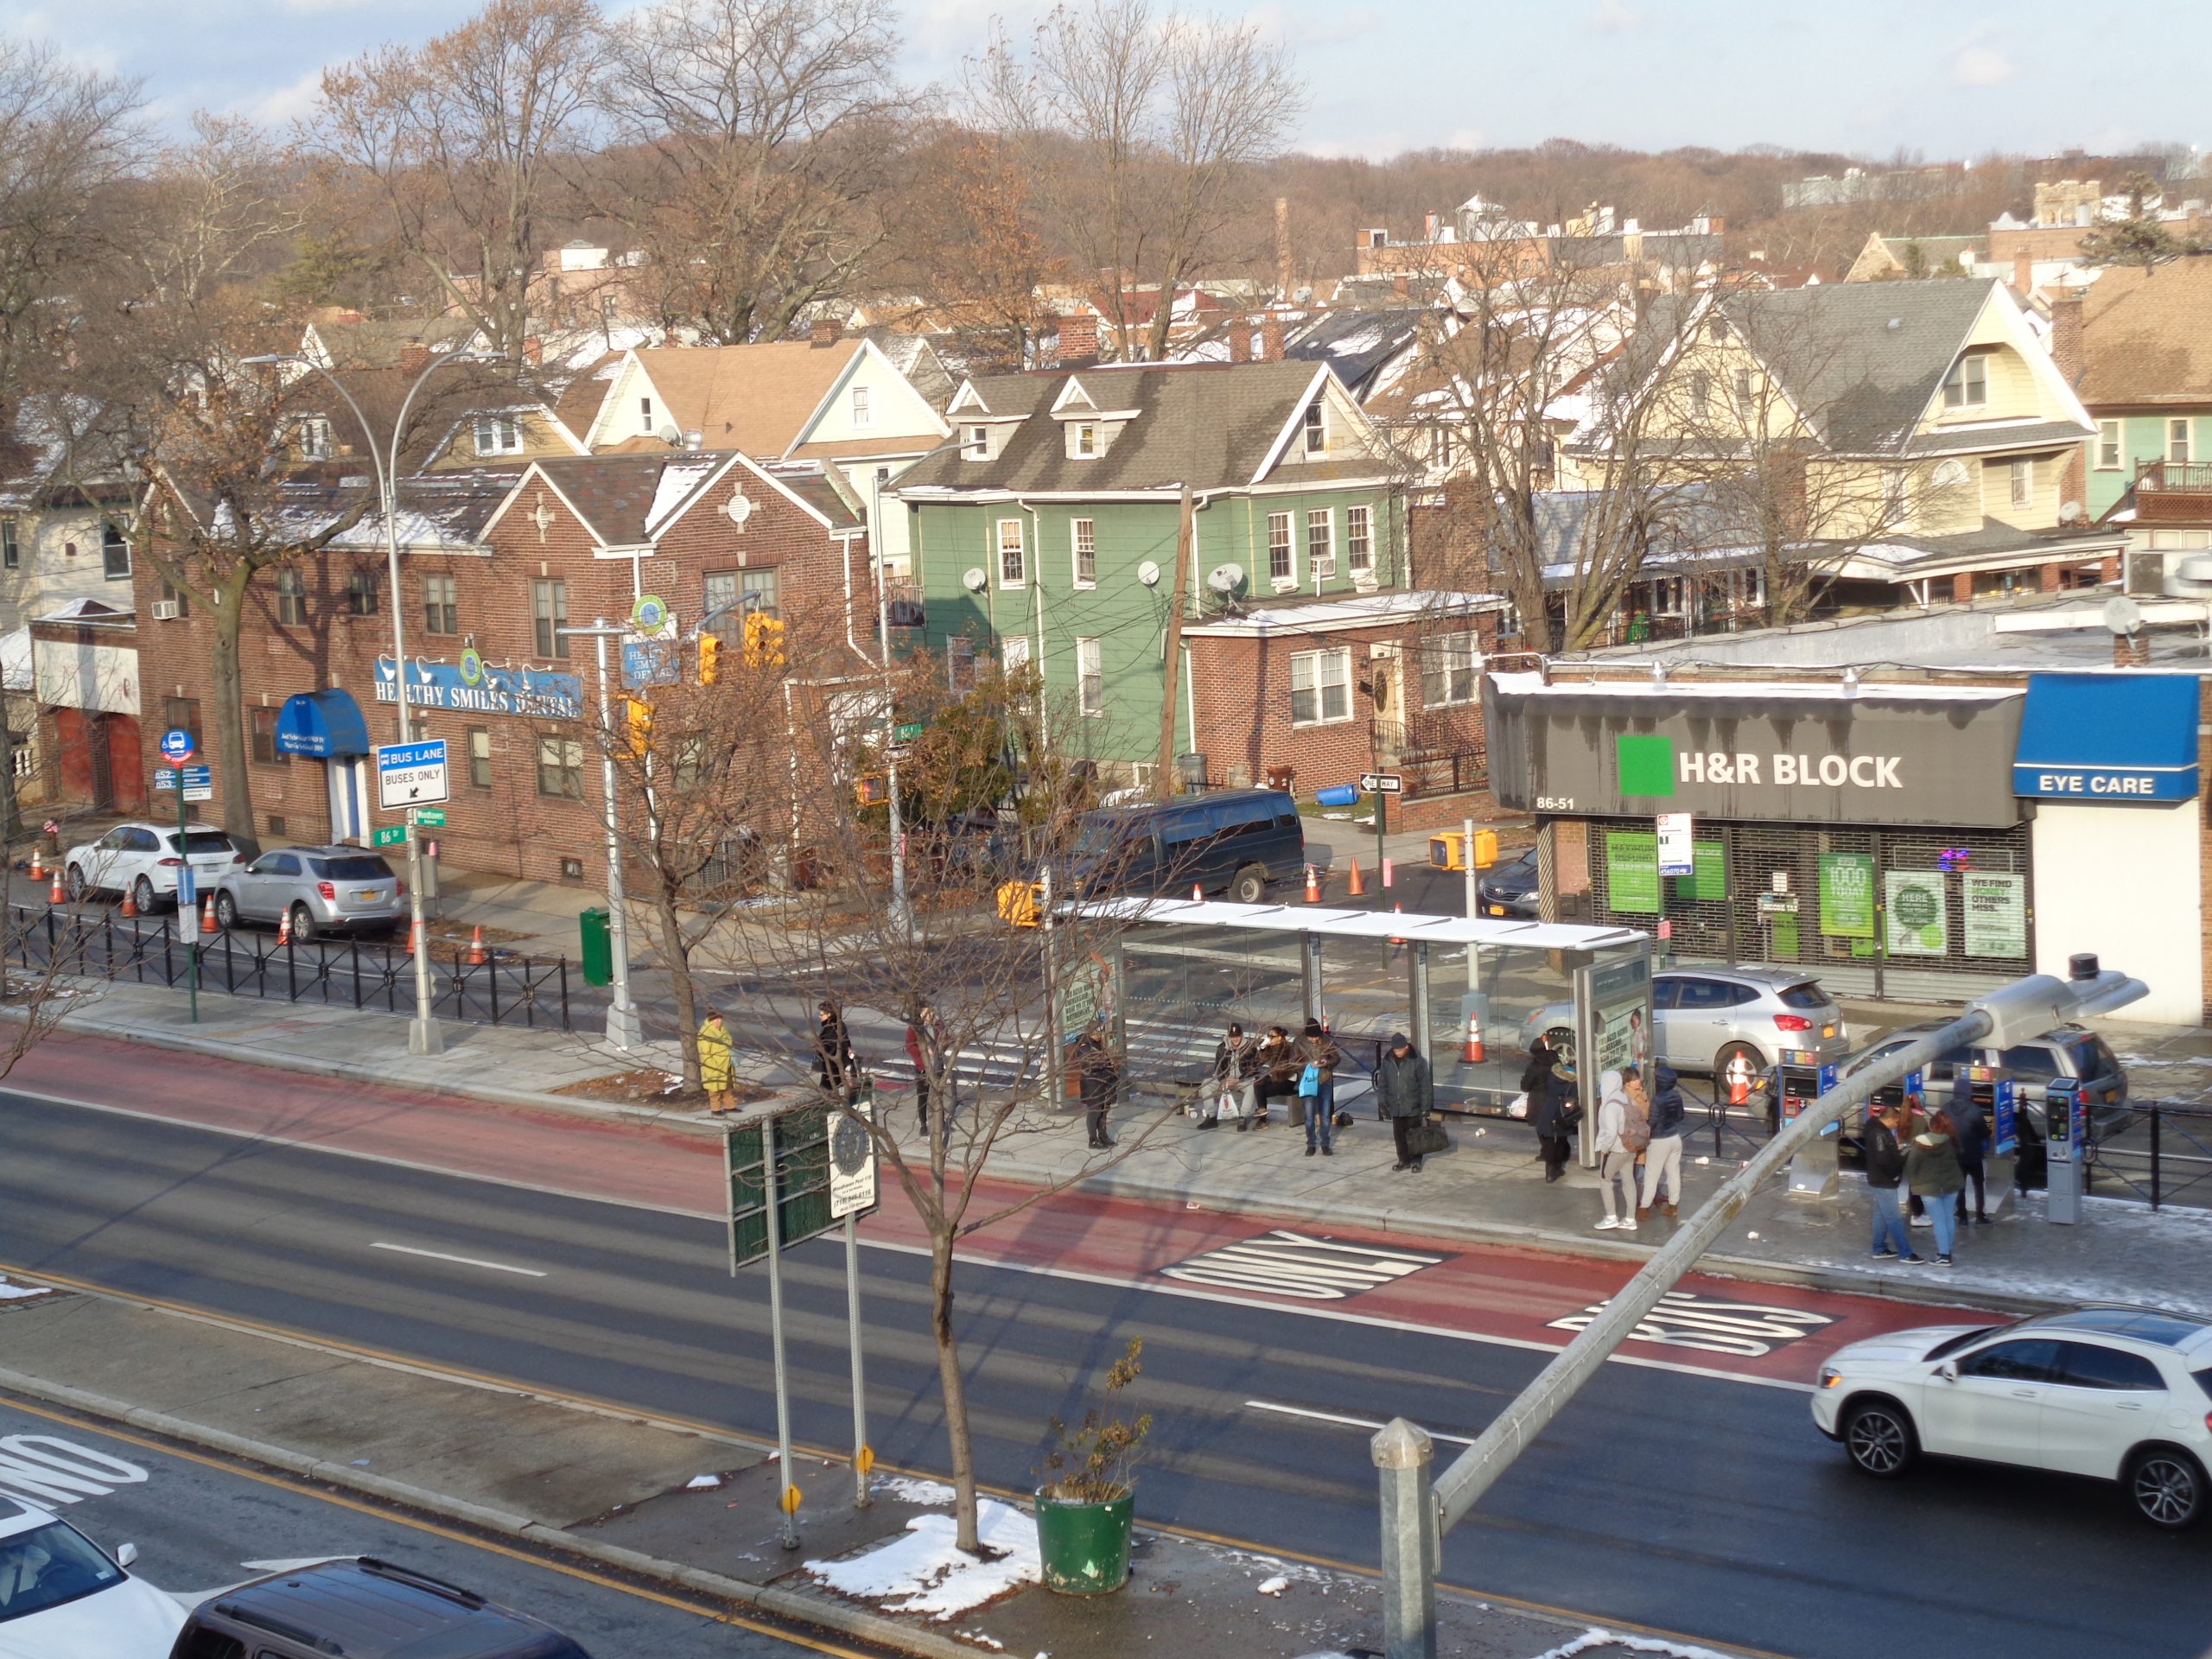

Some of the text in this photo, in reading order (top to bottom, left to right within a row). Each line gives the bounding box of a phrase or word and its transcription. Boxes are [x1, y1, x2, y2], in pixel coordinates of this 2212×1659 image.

[375, 681, 444, 706] HELTHY
[450, 687, 509, 712] SMILES
[391, 747, 444, 764] BUS LANE
[385, 768, 441, 785] BUSES ONLY
[1679, 752, 1903, 789] H&R BLOCK
[2039, 774, 2154, 794] EYE CARE
[1536, 797, 1574, 810] 86-51
[380, 830, 391, 844] 86
[1971, 880, 2012, 888] WE FIND
[1902, 893, 1929, 903] HERE
[1971, 895, 2012, 905] OTHERS
[1160, 1230, 1442, 1300] ONLY
[1545, 1291, 1834, 1357] BUS
